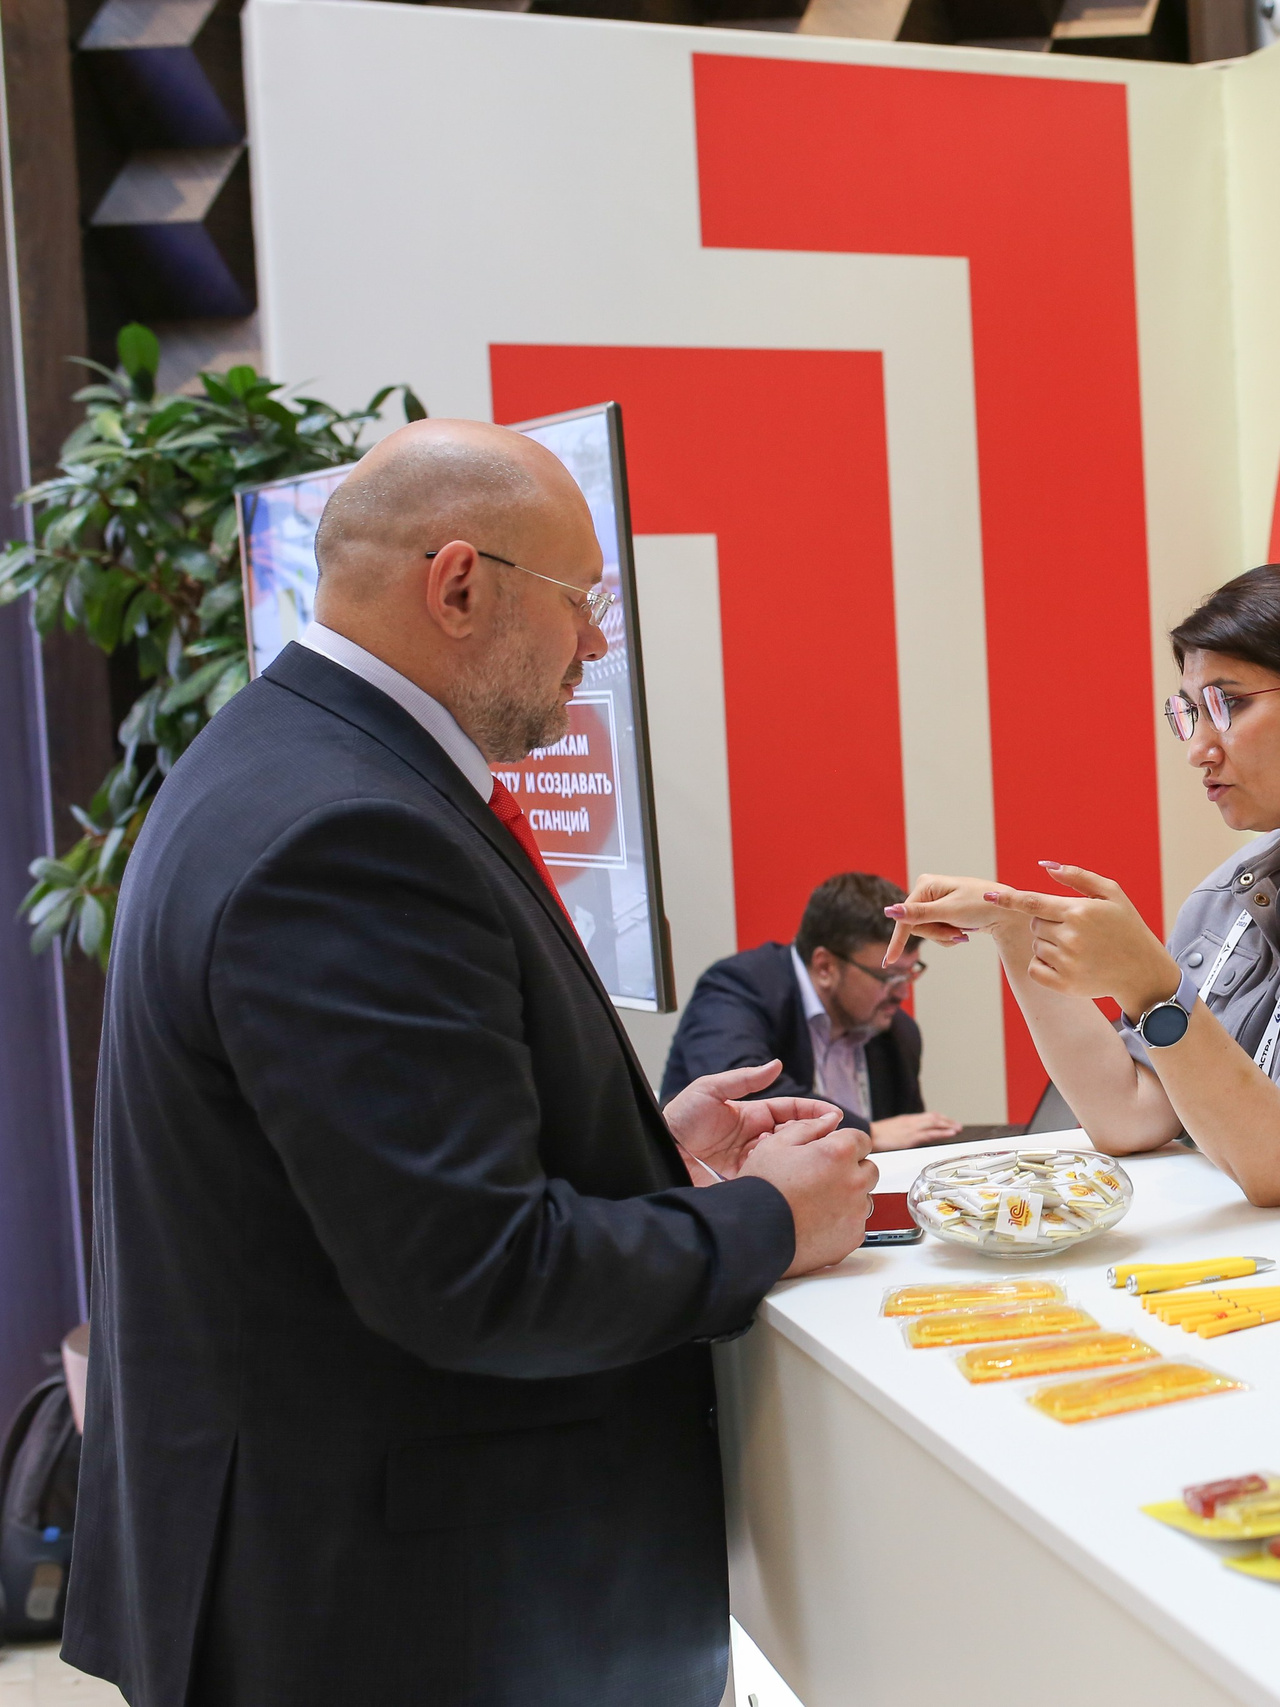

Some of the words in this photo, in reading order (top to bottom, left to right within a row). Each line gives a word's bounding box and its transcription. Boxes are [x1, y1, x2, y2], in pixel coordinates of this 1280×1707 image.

[490, 771, 521, 794] ОТУ
[525, 772, 536, 794] И
[537, 772, 613, 799] СОЗДАВАТЬ
[529, 807, 590, 836] СТАНЦИЙ
[1258, 1038, 1273, 1071] АСТРА
